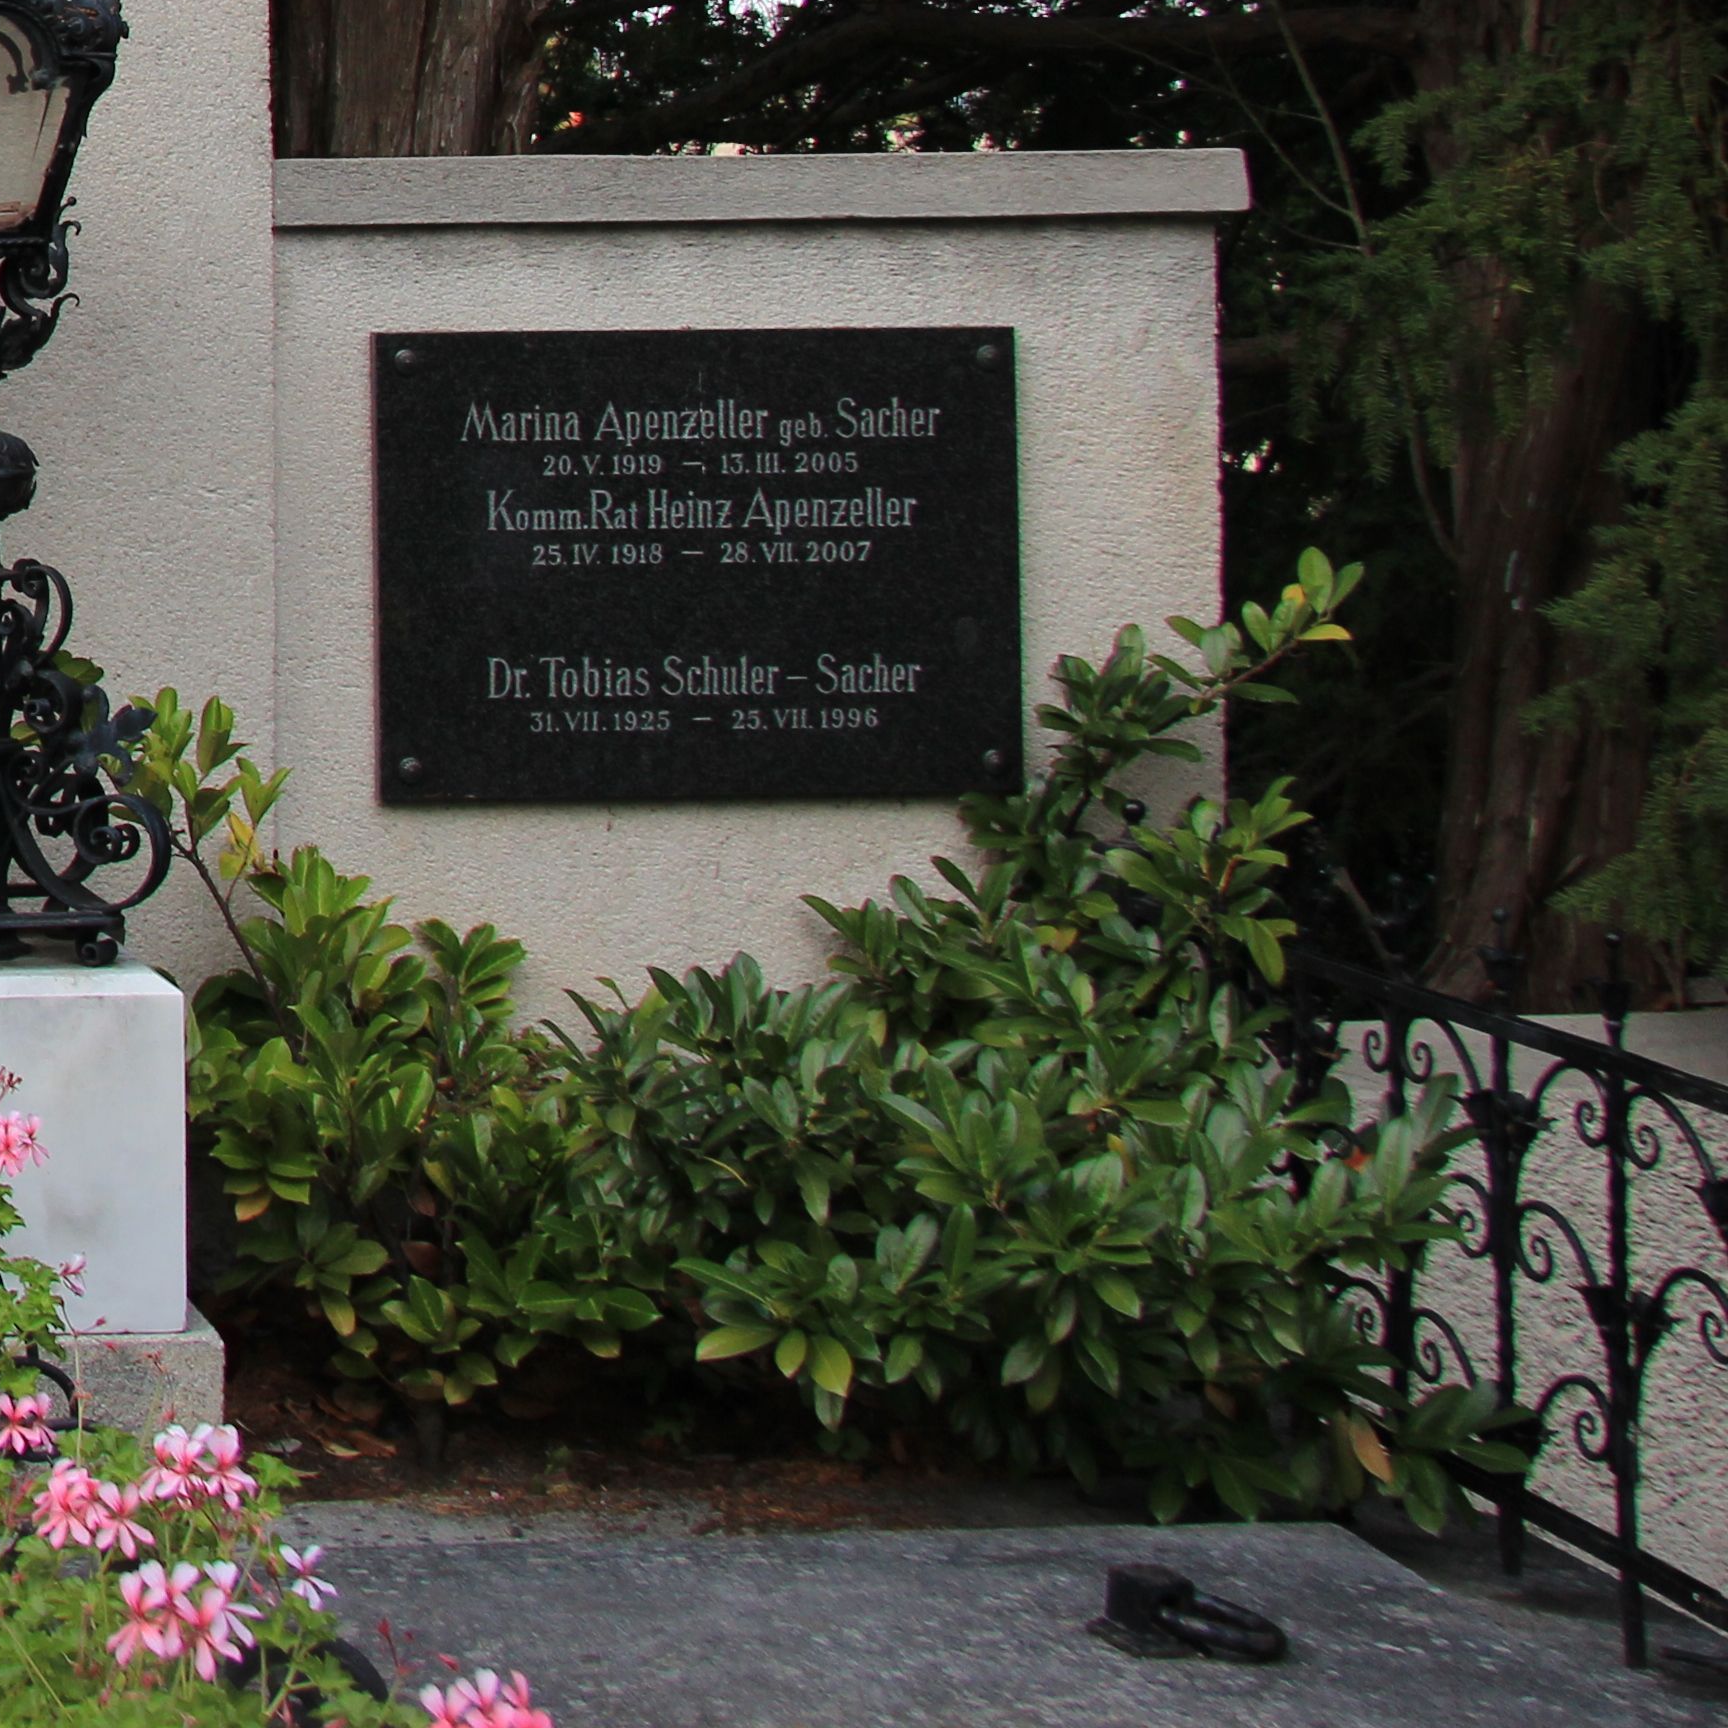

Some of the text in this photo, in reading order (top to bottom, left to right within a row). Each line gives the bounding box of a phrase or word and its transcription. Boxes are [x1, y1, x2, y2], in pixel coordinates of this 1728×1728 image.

[459, 396, 941, 447] Marina Apenzeller geb. Sacher
[647, 490, 733, 529] Heinz
[740, 487, 918, 536] Apenzeller
[487, 656, 531, 699] Dr.
[538, 655, 650, 697] Tobias
[660, 655, 780, 696] Schuler
[815, 653, 922, 693] Sacher
